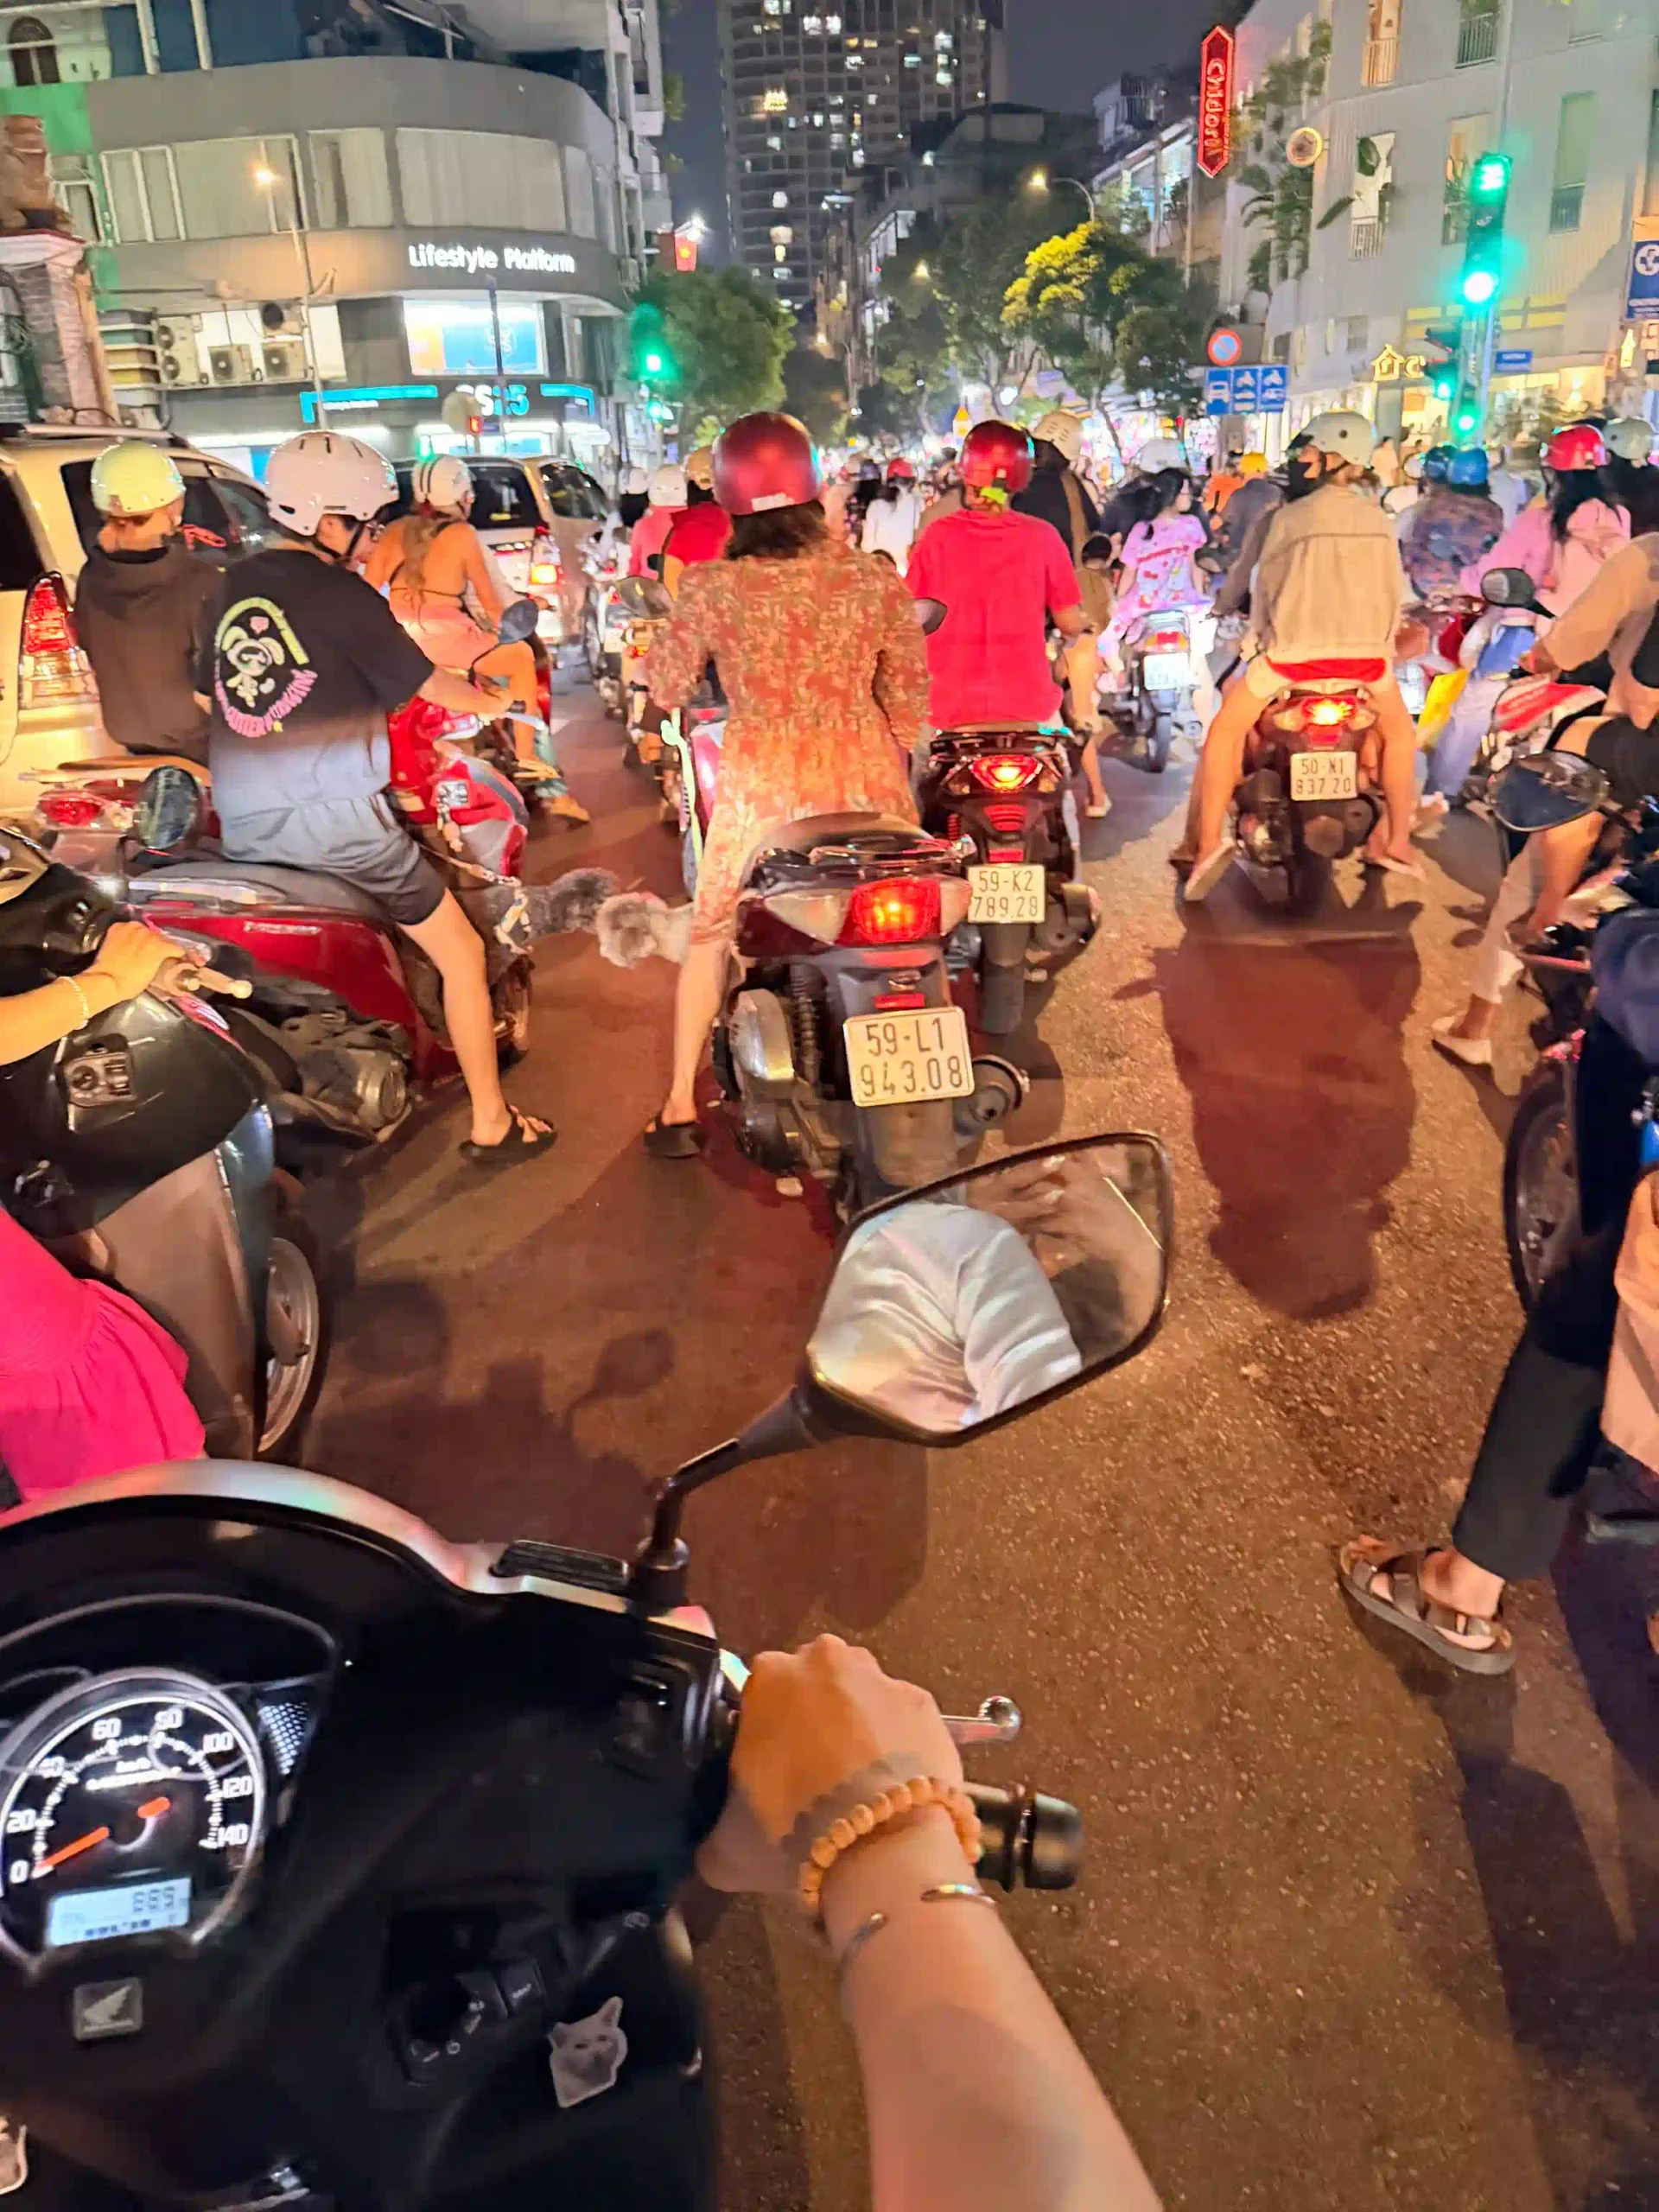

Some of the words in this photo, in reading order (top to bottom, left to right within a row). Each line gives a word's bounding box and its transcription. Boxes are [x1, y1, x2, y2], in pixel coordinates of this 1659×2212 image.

[409, 244, 498, 273] Lifestyle
[504, 247, 575, 273] Platform
[979, 870, 1033, 893] 59-K2
[973, 896, 1038, 918] 789.28
[865, 1017, 944, 1056] 59-L1
[860, 1056, 963, 1097] 943.08
[92, 1718, 121, 1740] 60
[202, 1732, 233, 1753] 100
[222, 1776, 252, 1798] 120
[6, 1808, 37, 1834] 20
[218, 1823, 249, 1847] 140
[10, 1859, 29, 1884] 0
